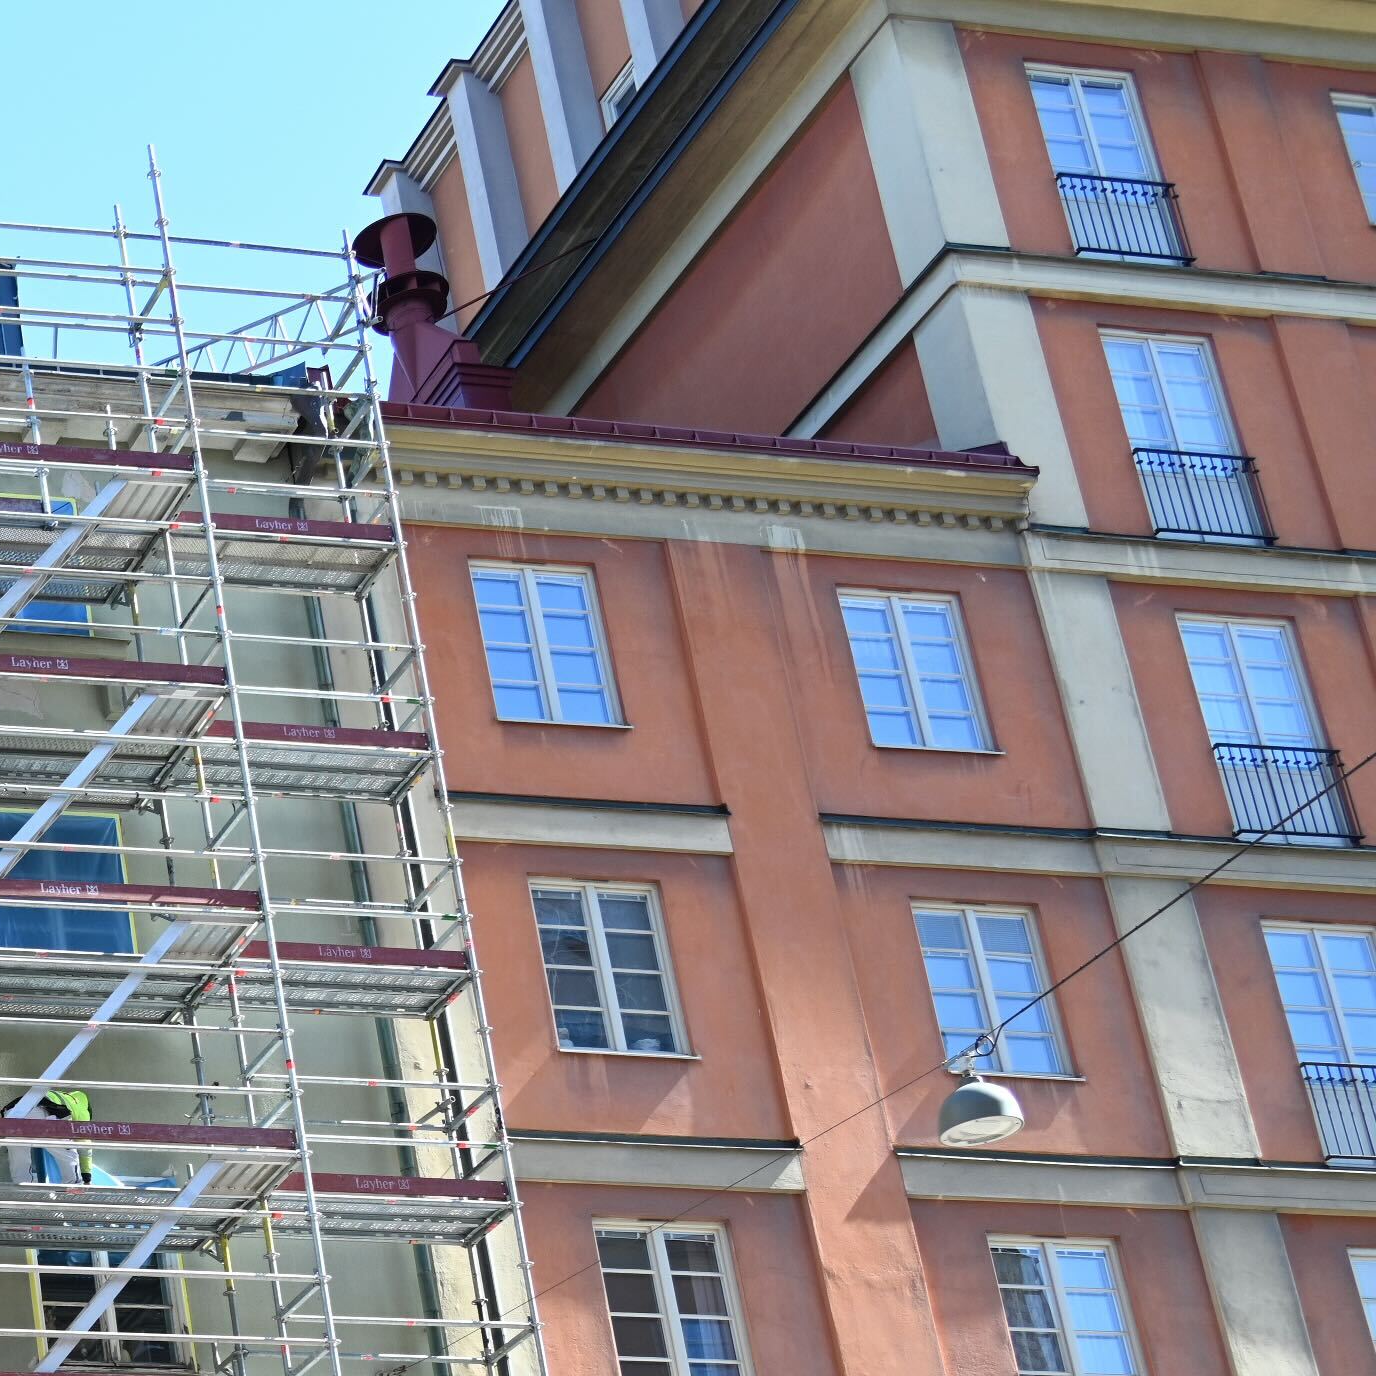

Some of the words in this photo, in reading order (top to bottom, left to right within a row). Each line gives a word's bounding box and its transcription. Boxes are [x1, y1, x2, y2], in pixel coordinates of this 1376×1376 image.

[255, 519, 292, 532] Layher
[11, 657, 52, 671] Layher
[284, 726, 320, 739] Layher
[40, 882, 80, 896] Layher
[319, 946, 355, 959] Layher
[71, 1122, 114, 1137] Layher
[355, 1177, 394, 1190] Layher
